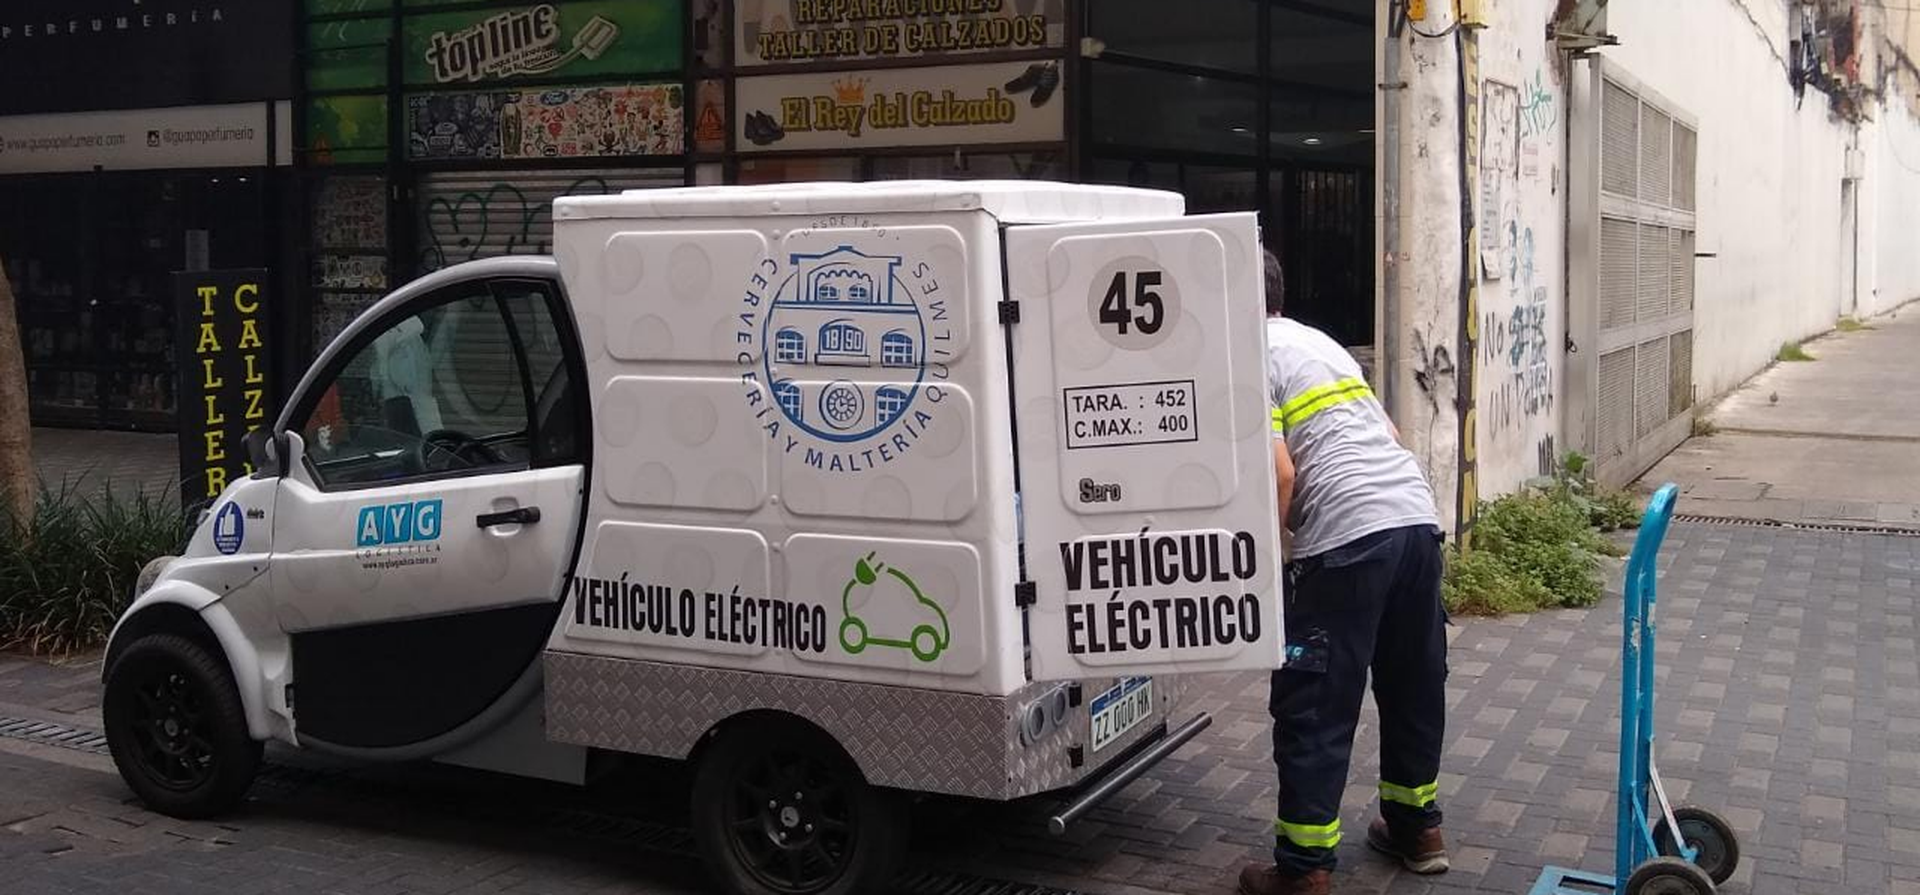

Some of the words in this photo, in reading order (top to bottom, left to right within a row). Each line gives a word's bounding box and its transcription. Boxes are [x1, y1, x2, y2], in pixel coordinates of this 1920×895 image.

[758, 26, 858, 60] TALLER
[864, 21, 900, 53] DE
[905, 16, 1046, 48] CALZADOS
[780, 95, 808, 132] El
[814, 97, 863, 136] Rey
[868, 93, 909, 129] del
[911, 88, 1016, 127] Calzado
[1099, 271, 1165, 335] 45
[234, 284, 264, 432] CALZ
[825, 325, 863, 350] 1890
[784, 434, 799, 455] Y
[804, 409, 932, 473] MALTERÍA
[911, 261, 951, 404] QUILMES
[196, 286, 226, 498] TALLER
[1072, 393, 1128, 413] TARA.
[1155, 389, 1187, 408] 452
[1158, 414, 1189, 433] 400
[1079, 478, 1122, 503] Sero
[359, 502, 437, 543] AYG
[1060, 526, 1257, 591] VEHÍCULO
[574, 571, 696, 638] VEHÍCULO
[704, 585, 827, 653] ELÉCTRICO
[1066, 590, 1262, 654] ELÉCTRICO
[1094, 711, 1111, 746] ZZ
